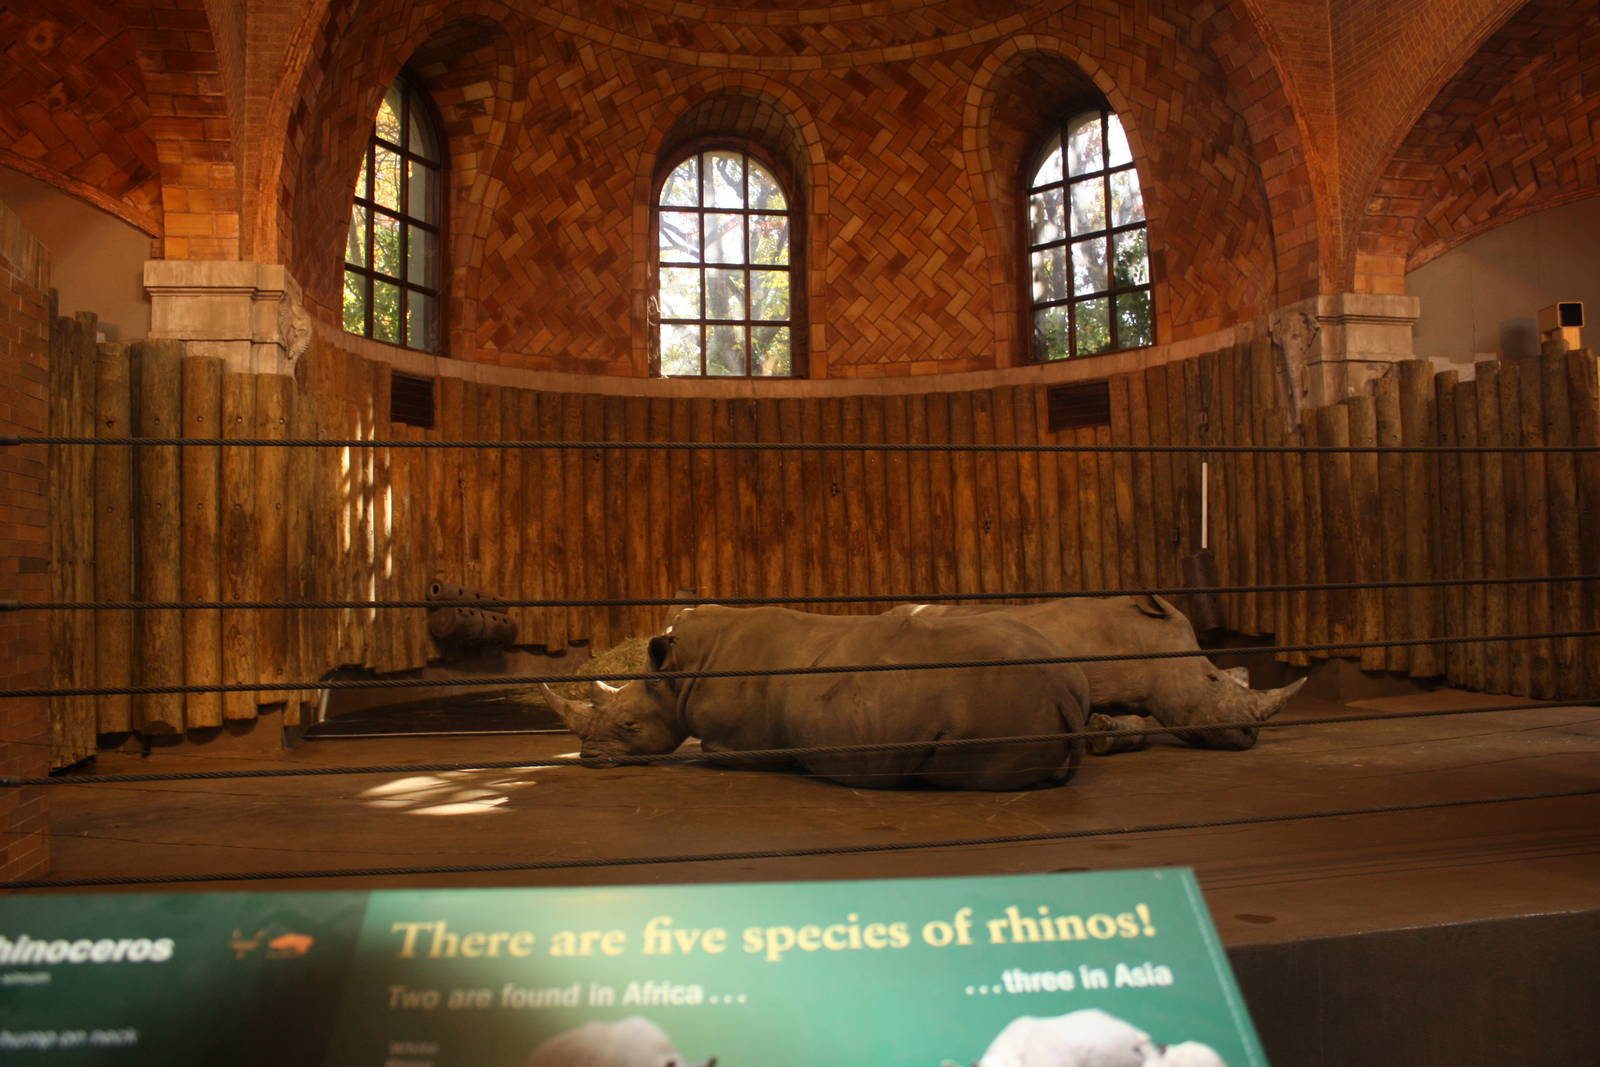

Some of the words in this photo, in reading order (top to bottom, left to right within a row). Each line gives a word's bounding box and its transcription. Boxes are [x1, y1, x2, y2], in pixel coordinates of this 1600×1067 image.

[391, 920, 534, 958] There
[549, 930, 627, 957] are
[642, 915, 727, 955] five
[742, 911, 911, 962] species
[922, 907, 974, 947] of
[987, 903, 1157, 944] rhinos!
[1080, 965, 1108, 990] in
[1115, 962, 1174, 988] Asia
[388, 985, 439, 1010] Two
[447, 987, 494, 1010] are
[500, 981, 582, 1008] found
[588, 981, 616, 1007] in
